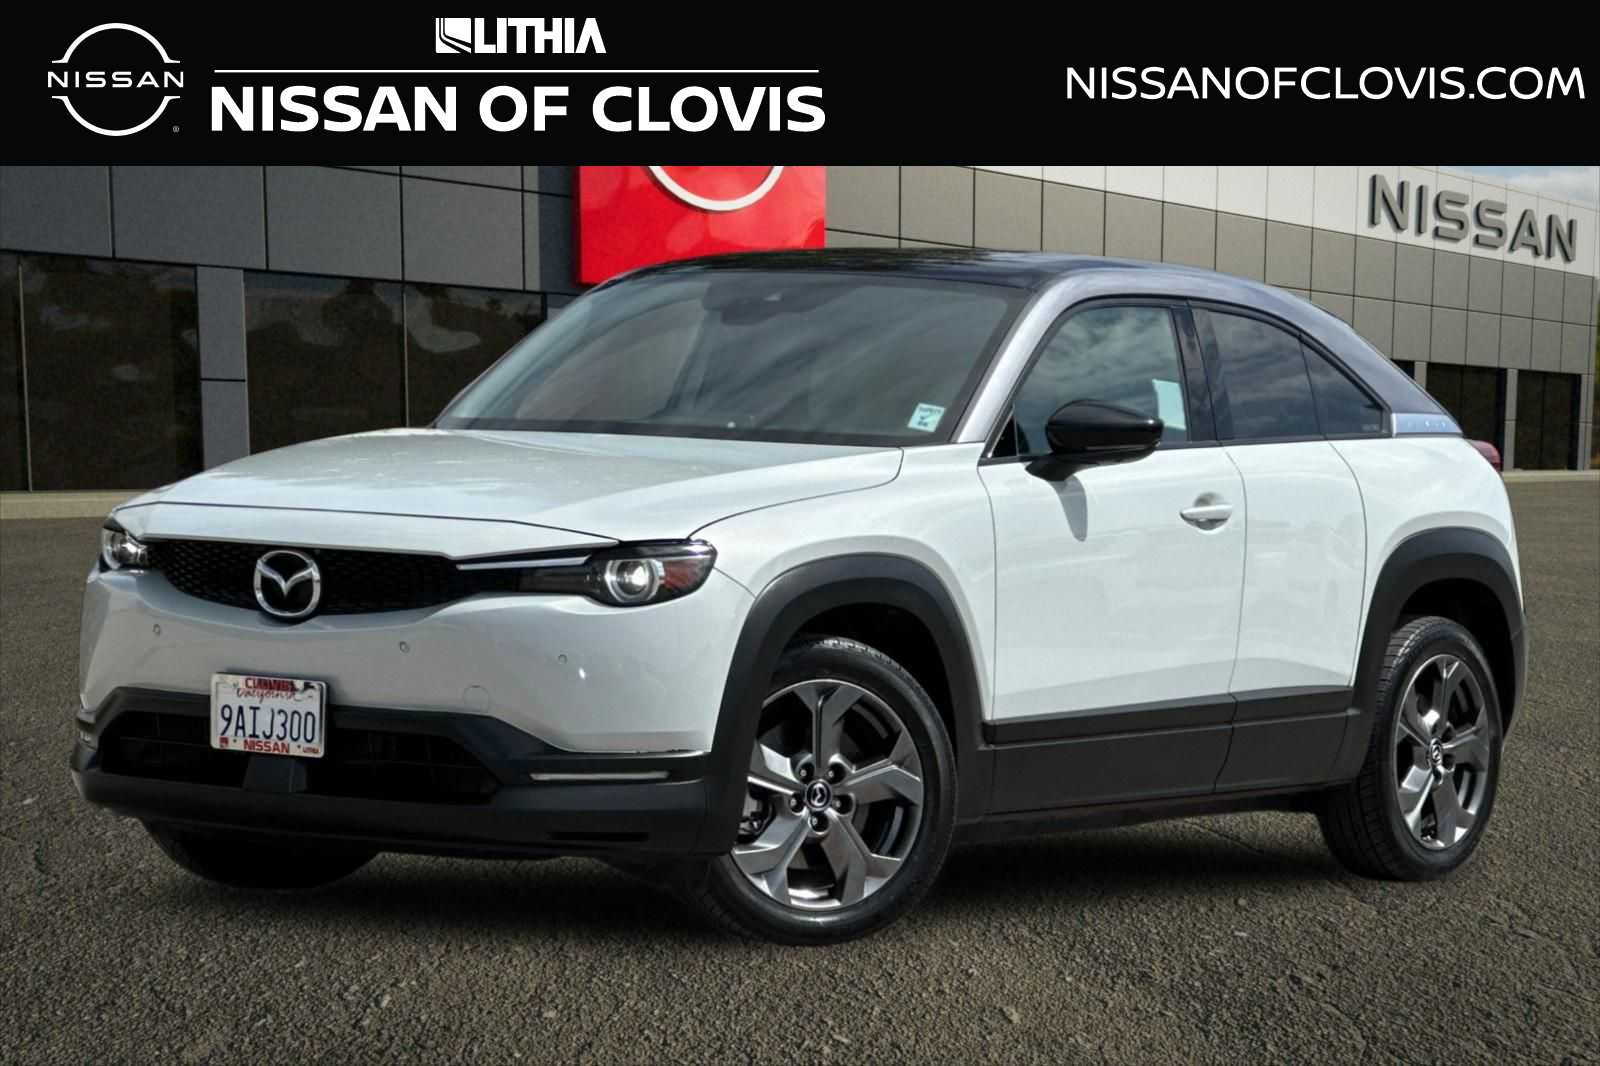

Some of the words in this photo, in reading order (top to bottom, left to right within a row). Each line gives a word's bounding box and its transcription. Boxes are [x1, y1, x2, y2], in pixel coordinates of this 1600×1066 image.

[1369, 173, 1577, 263] NISSAN
[220, 704, 316, 743] 9AIJ300
[243, 738, 290, 754] NISSAN
